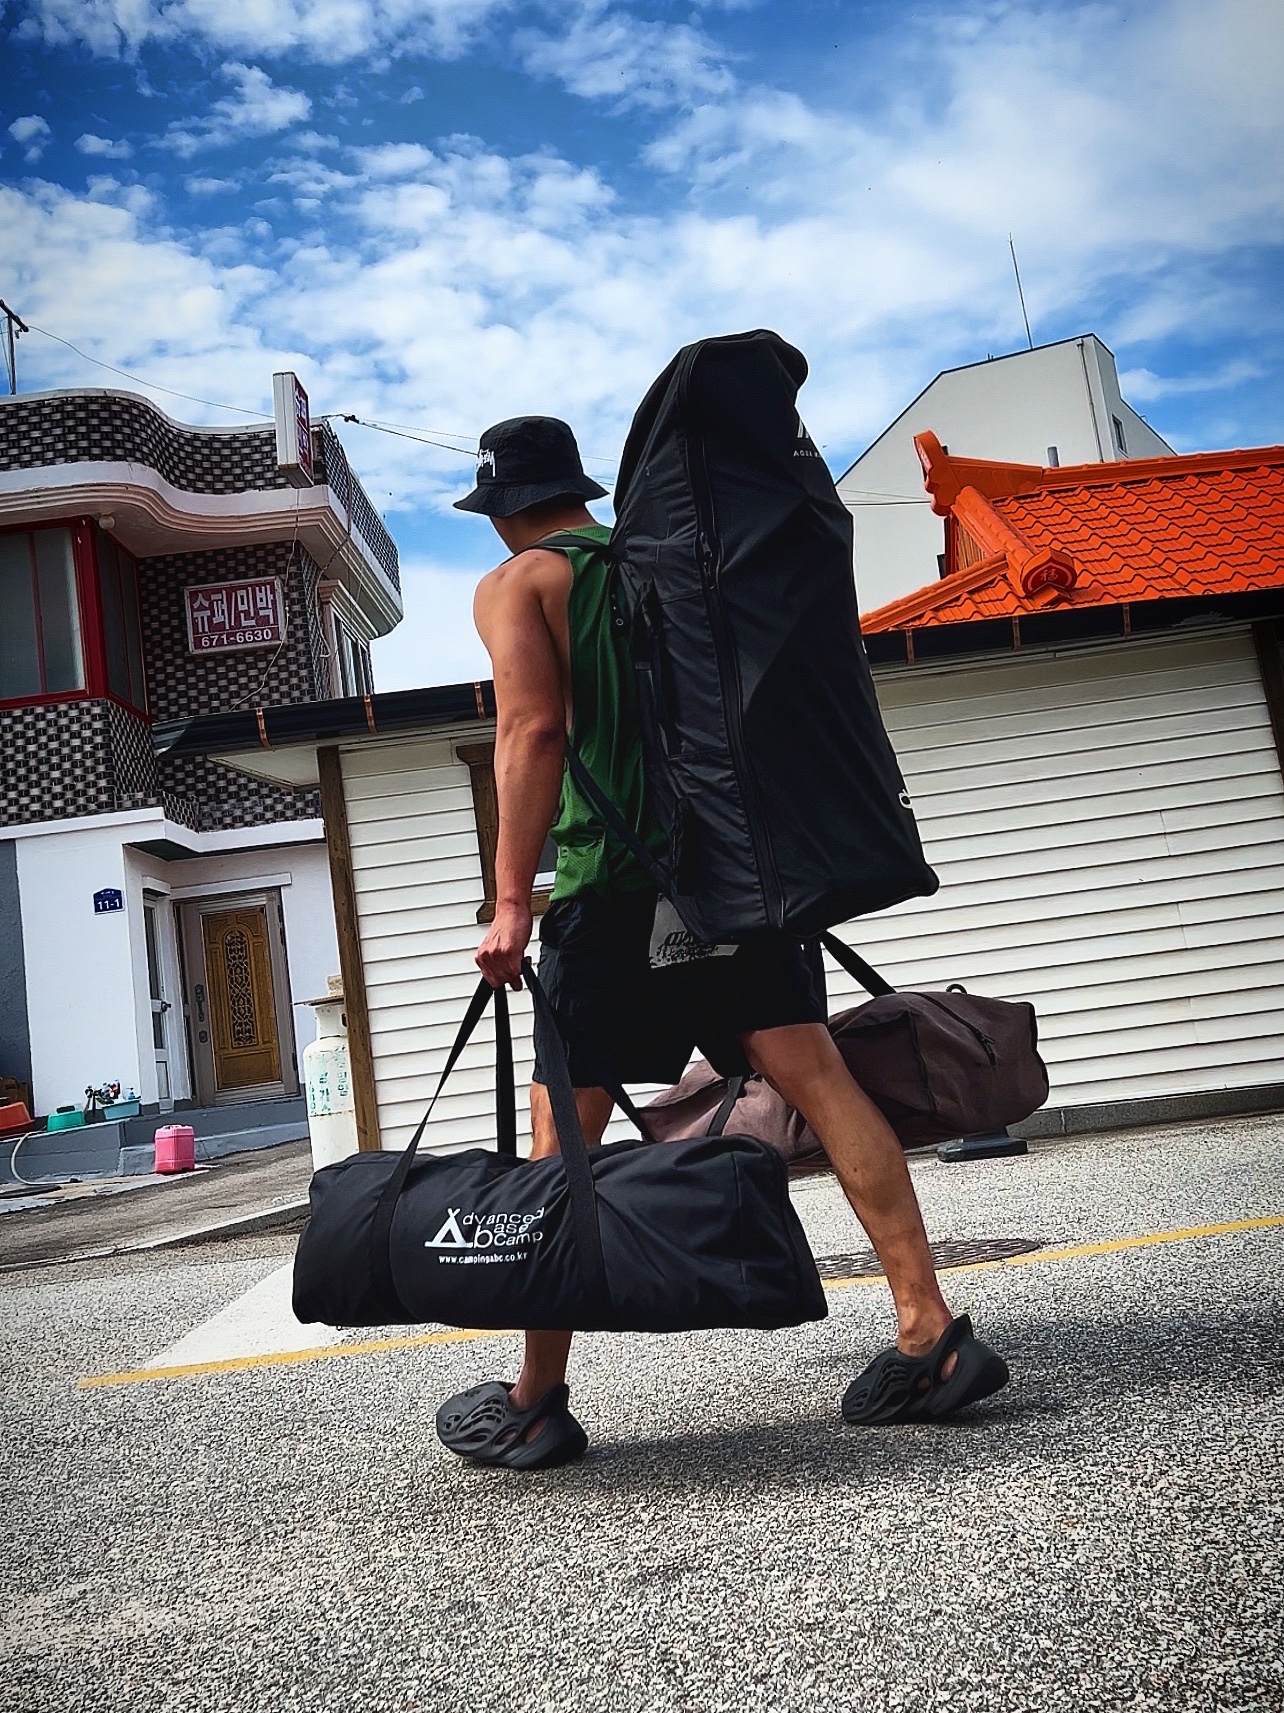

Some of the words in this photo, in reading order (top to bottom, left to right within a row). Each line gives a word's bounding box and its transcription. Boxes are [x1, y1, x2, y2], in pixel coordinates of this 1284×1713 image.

[193, 585, 275, 632] 슈퍼/민박
[201, 628, 272, 647] 671-6630
[97, 898, 120, 910] 11-1
[438, 1251, 528, 1265] www.campingabc.co.kr
